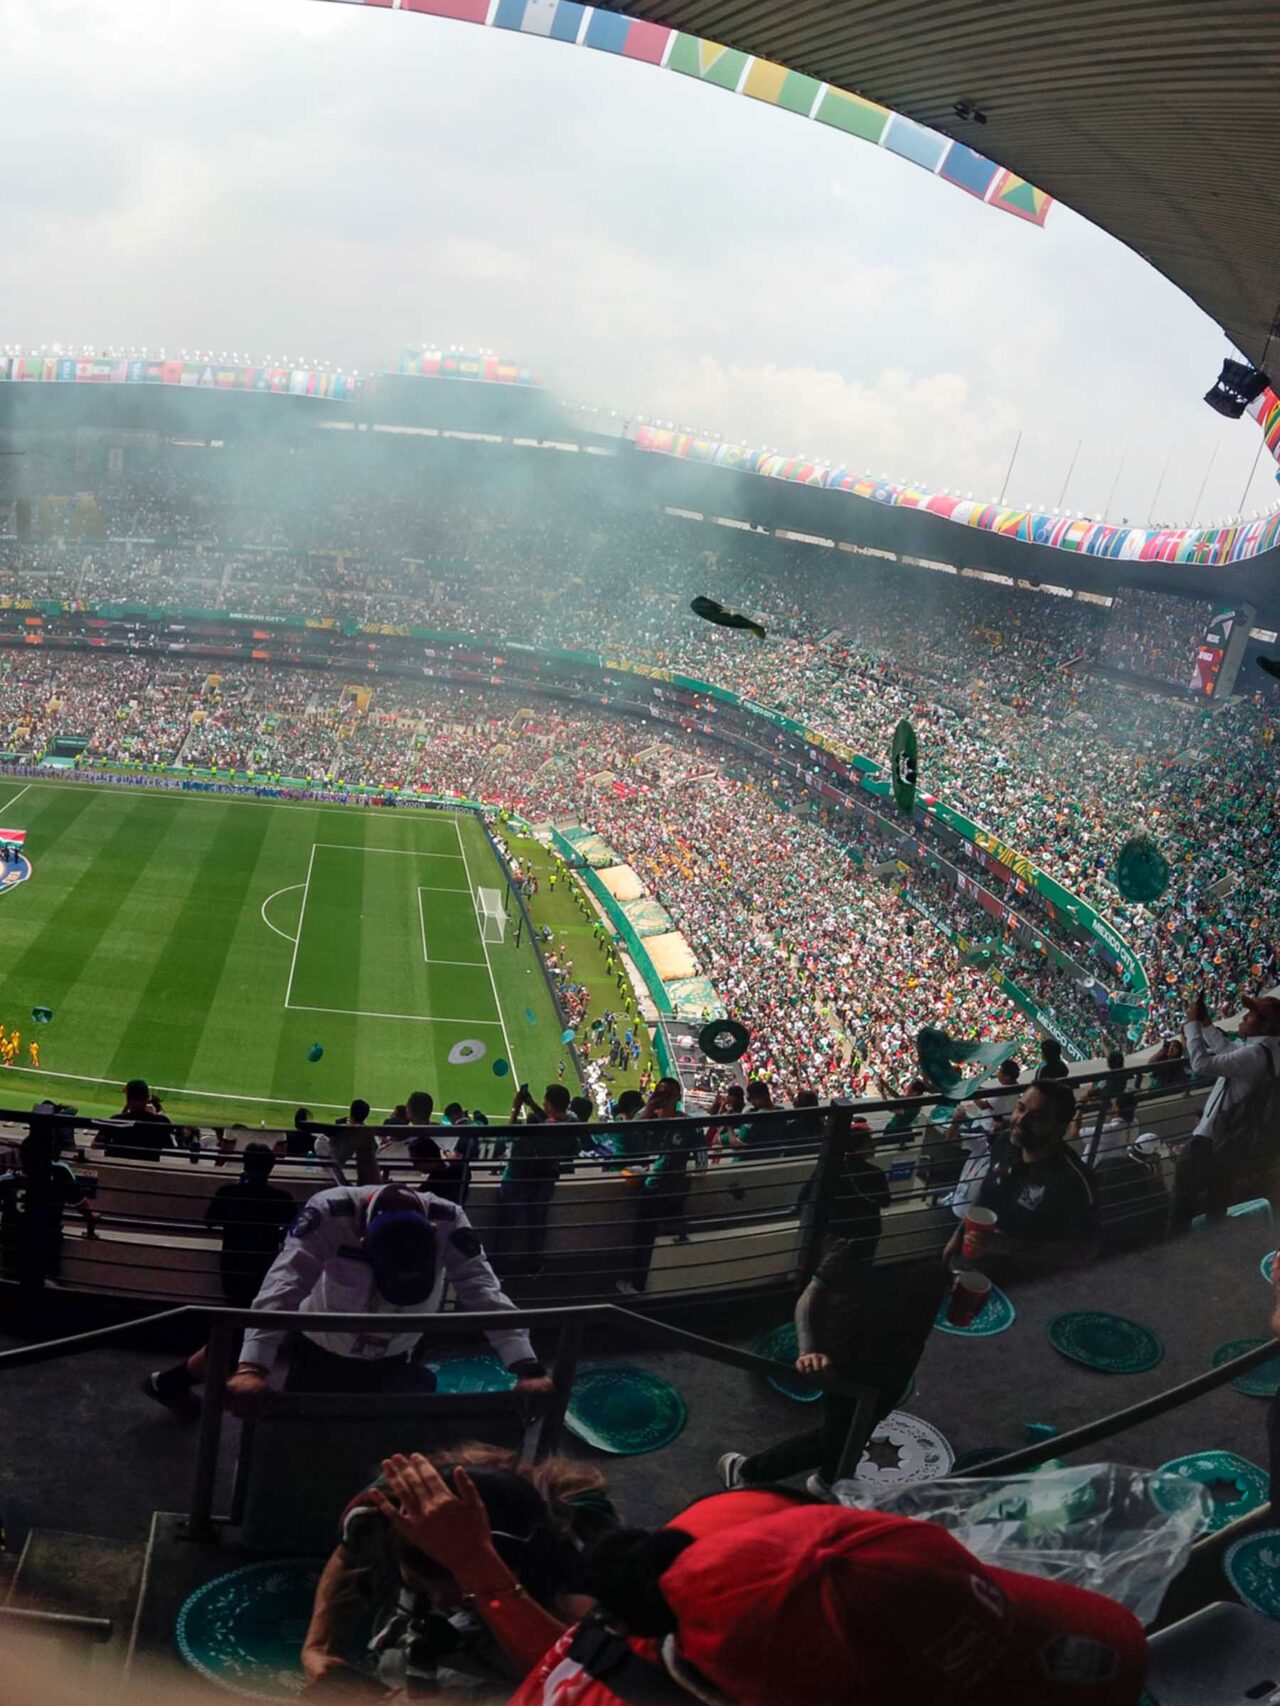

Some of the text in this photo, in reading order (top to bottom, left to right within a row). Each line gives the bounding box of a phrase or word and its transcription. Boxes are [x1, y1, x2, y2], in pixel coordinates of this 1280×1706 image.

[229, 612, 264, 621] MEXICO
[1092, 918, 1135, 970] MEXICO CITY
[1036, 1011, 1067, 1047] MEXICO
[477, 1141, 497, 1160] 11
